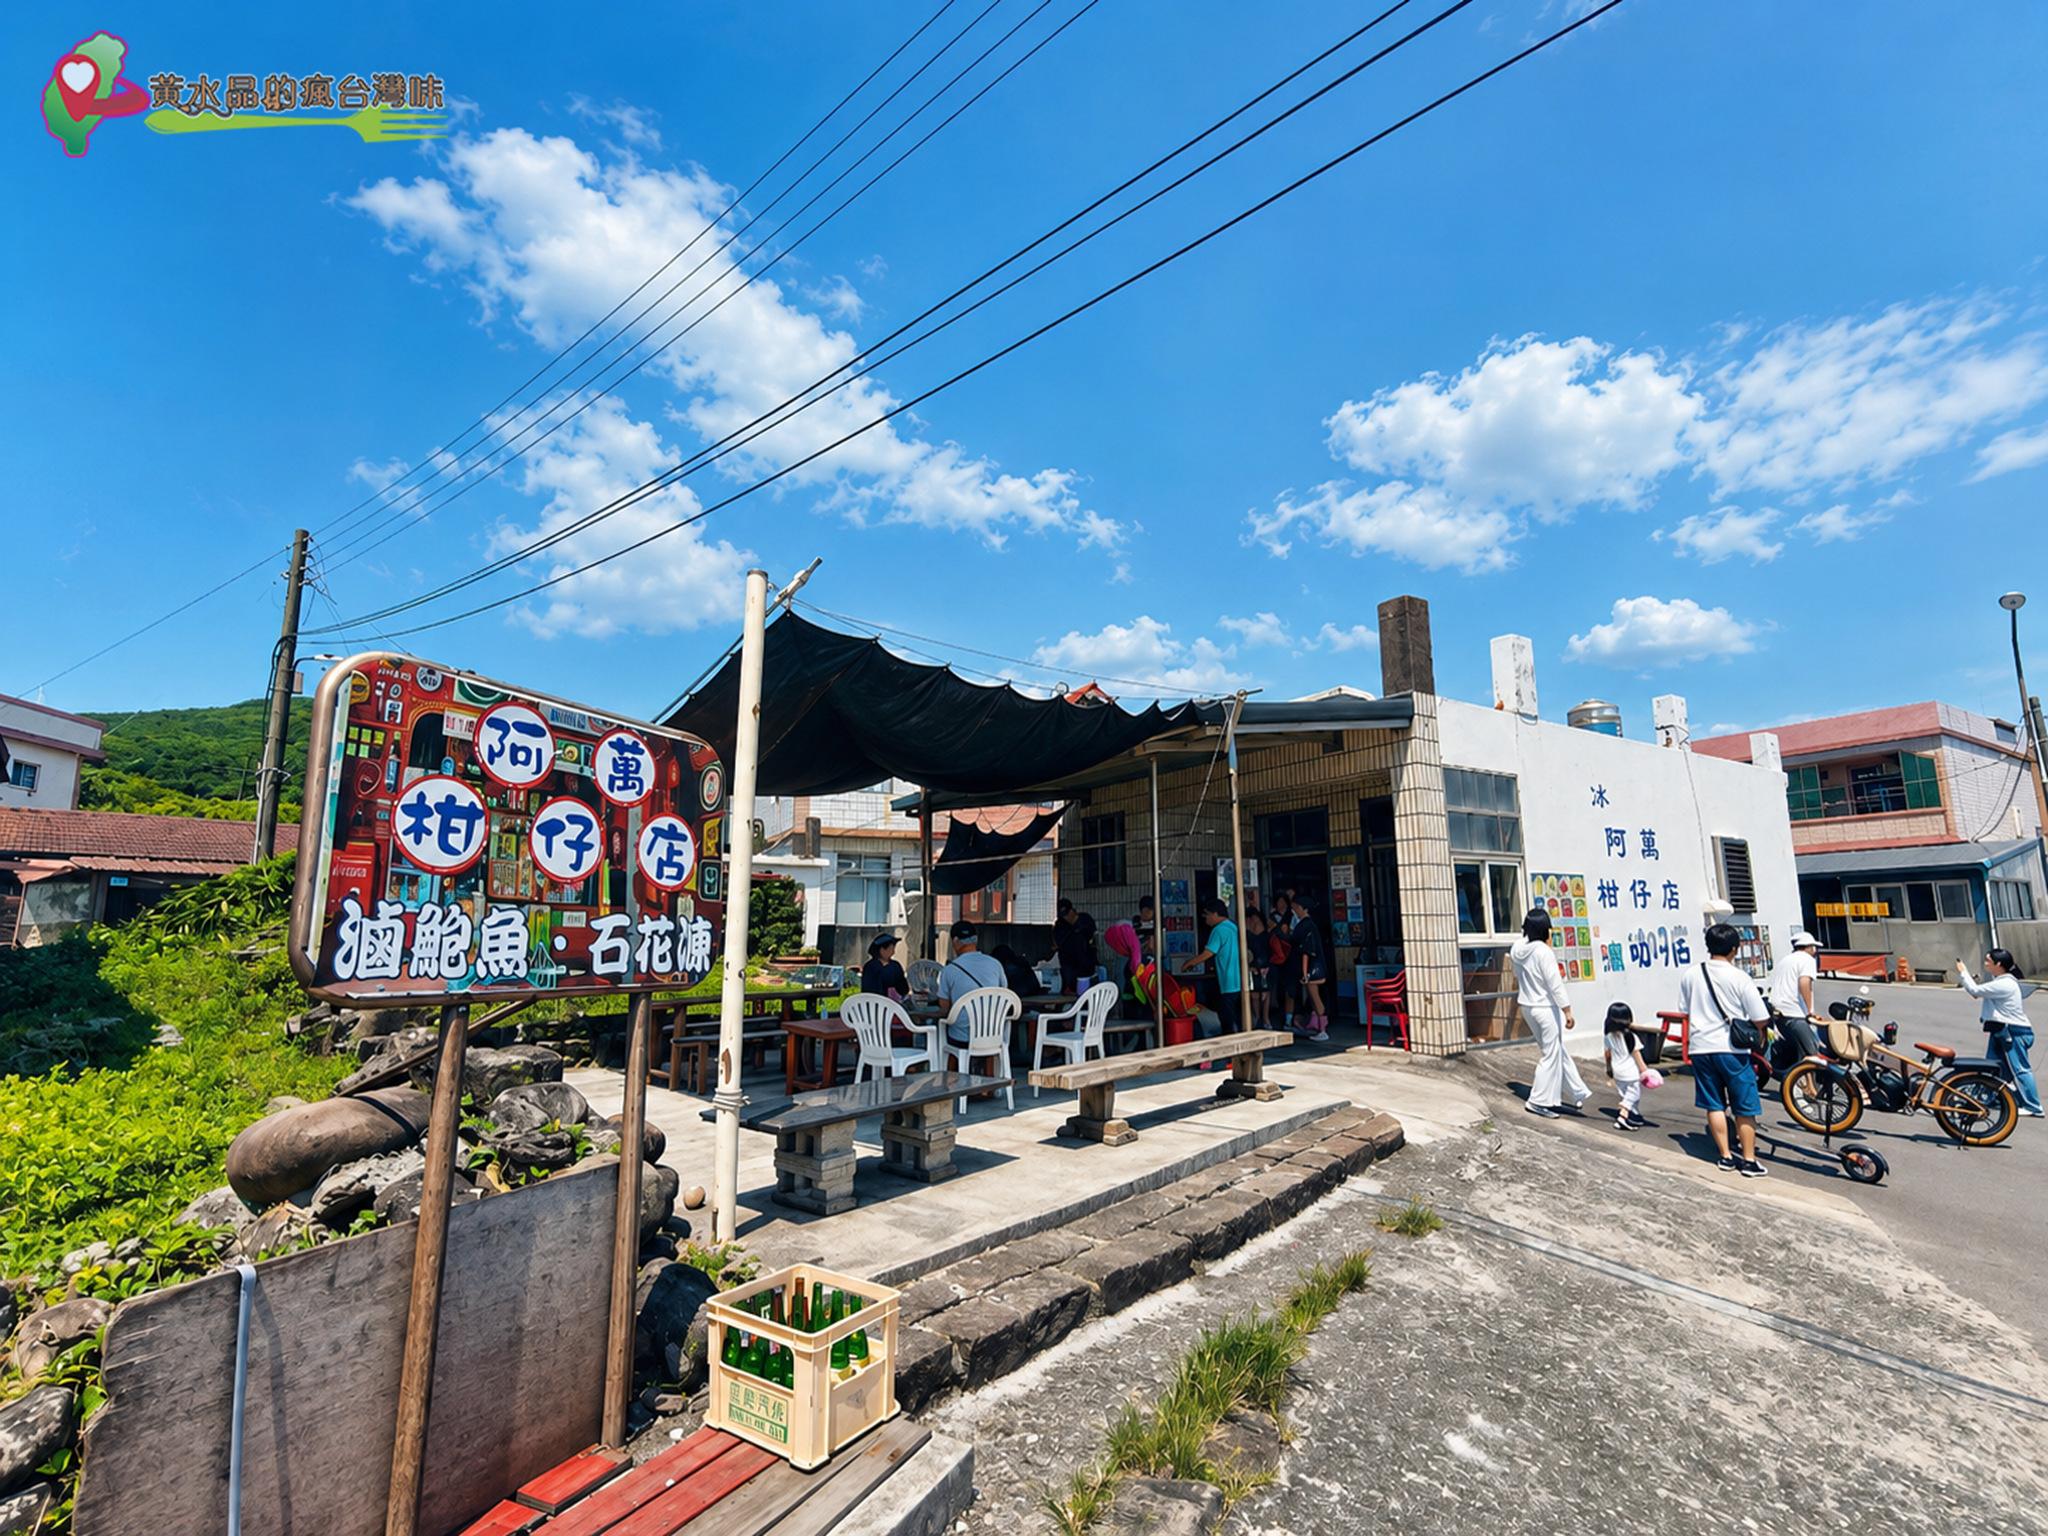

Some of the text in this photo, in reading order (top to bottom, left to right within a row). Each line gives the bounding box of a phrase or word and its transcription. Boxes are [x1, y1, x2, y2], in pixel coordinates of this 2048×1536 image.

[485, 715, 646, 797] 阿萬
[1589, 783, 1610, 808] 冰
[400, 790, 689, 882] 柑仔店
[1604, 827, 1660, 861] 阿萬
[1597, 878, 1680, 911] 柑仔店
